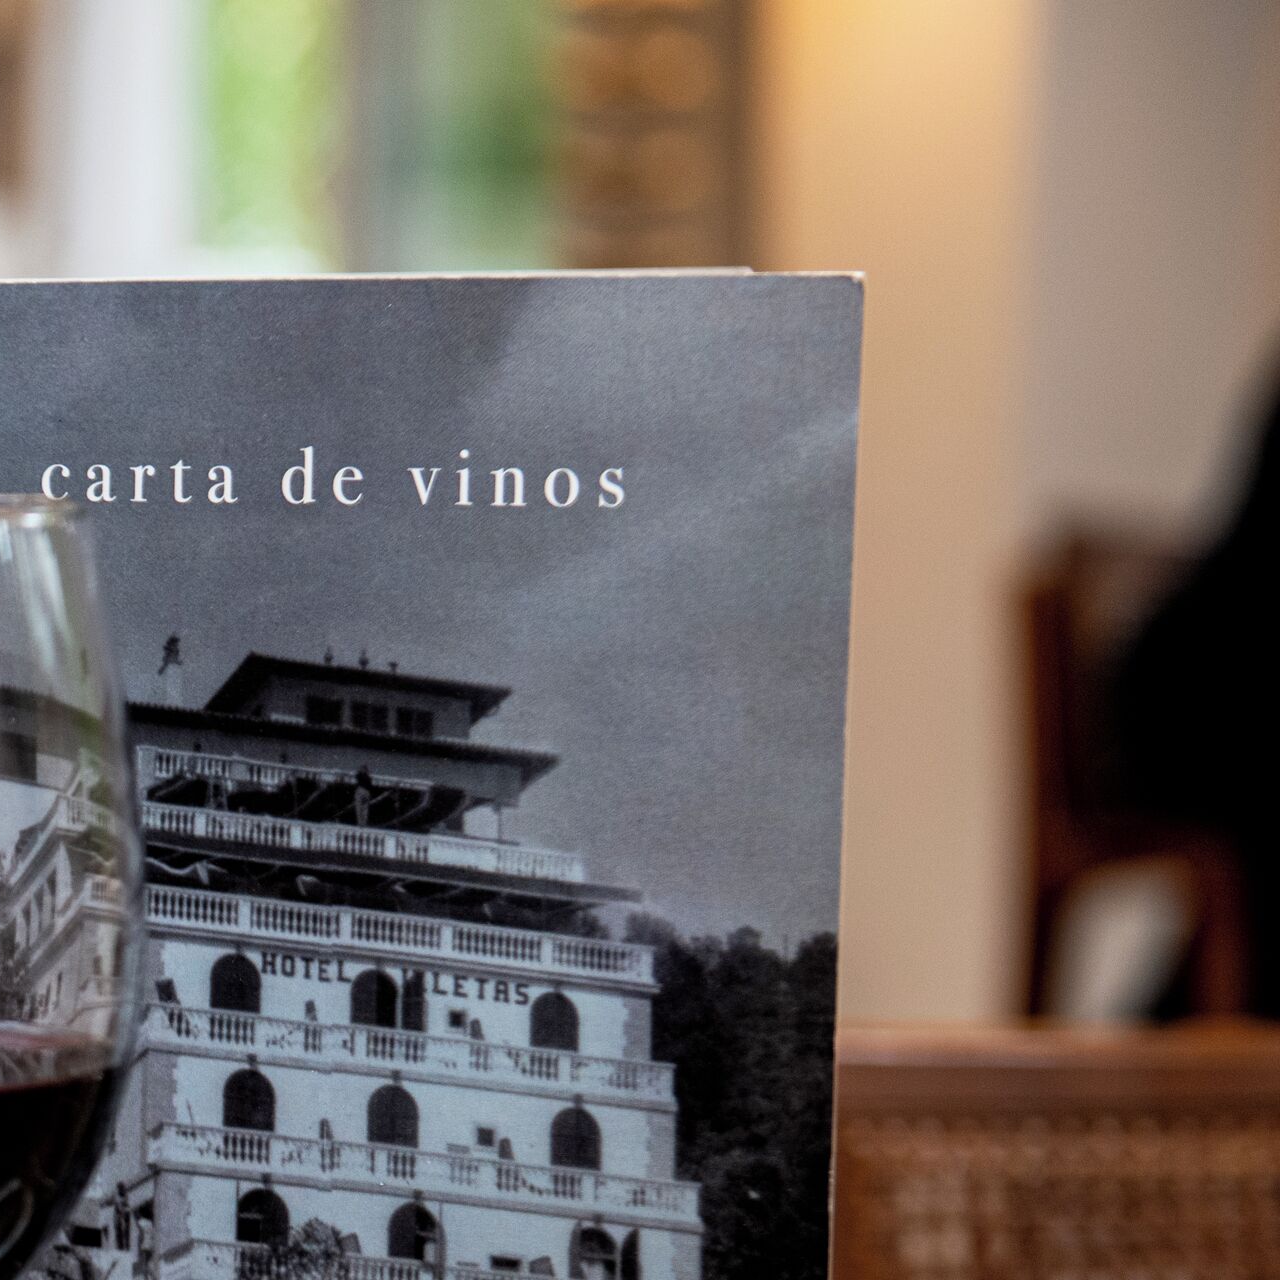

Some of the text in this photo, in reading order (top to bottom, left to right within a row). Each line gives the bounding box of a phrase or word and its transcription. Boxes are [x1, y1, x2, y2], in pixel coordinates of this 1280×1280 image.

[40, 446, 626, 508] carta de vinos
[261, 951, 352, 983] HOTEL
